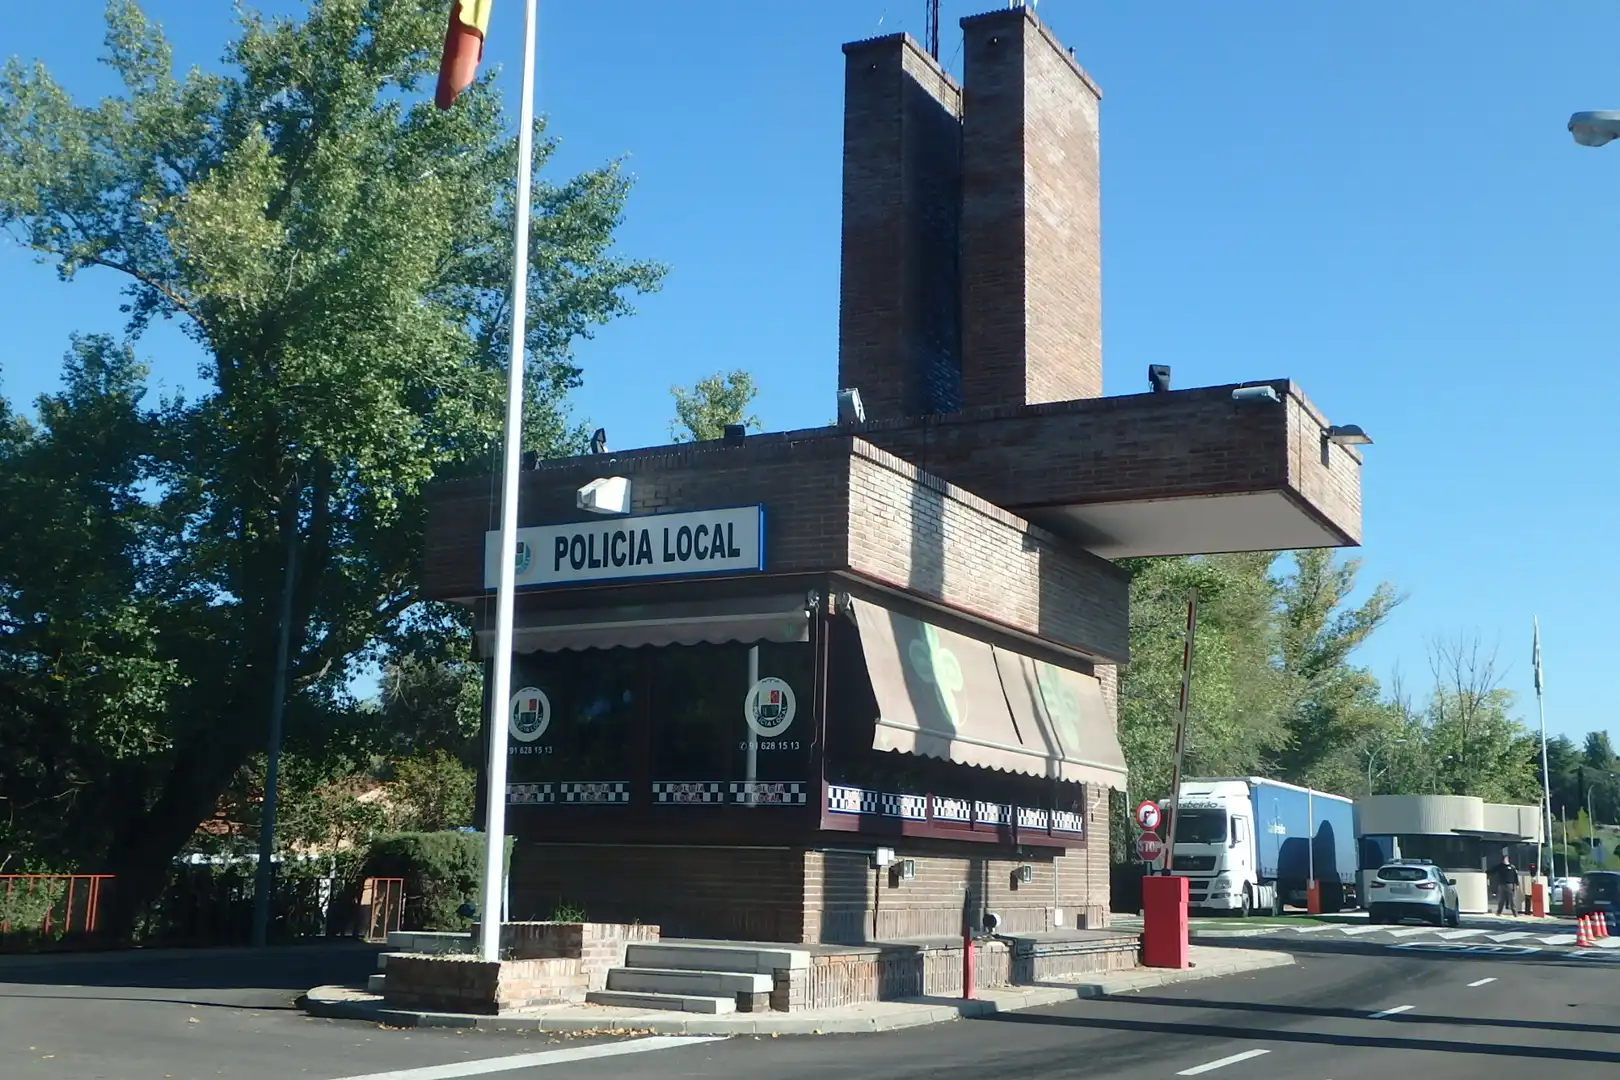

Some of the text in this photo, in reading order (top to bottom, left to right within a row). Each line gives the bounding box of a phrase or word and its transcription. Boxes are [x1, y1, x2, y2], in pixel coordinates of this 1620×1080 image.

[554, 529, 653, 571] POLICIA
[663, 522, 740, 562] LOCAL
[509, 746, 553, 754] 91 628 15 13
[761, 741, 775, 750] 628
[779, 741, 788, 750] 15
[790, 741, 800, 750] 13
[1138, 840, 1161, 853] STOP
